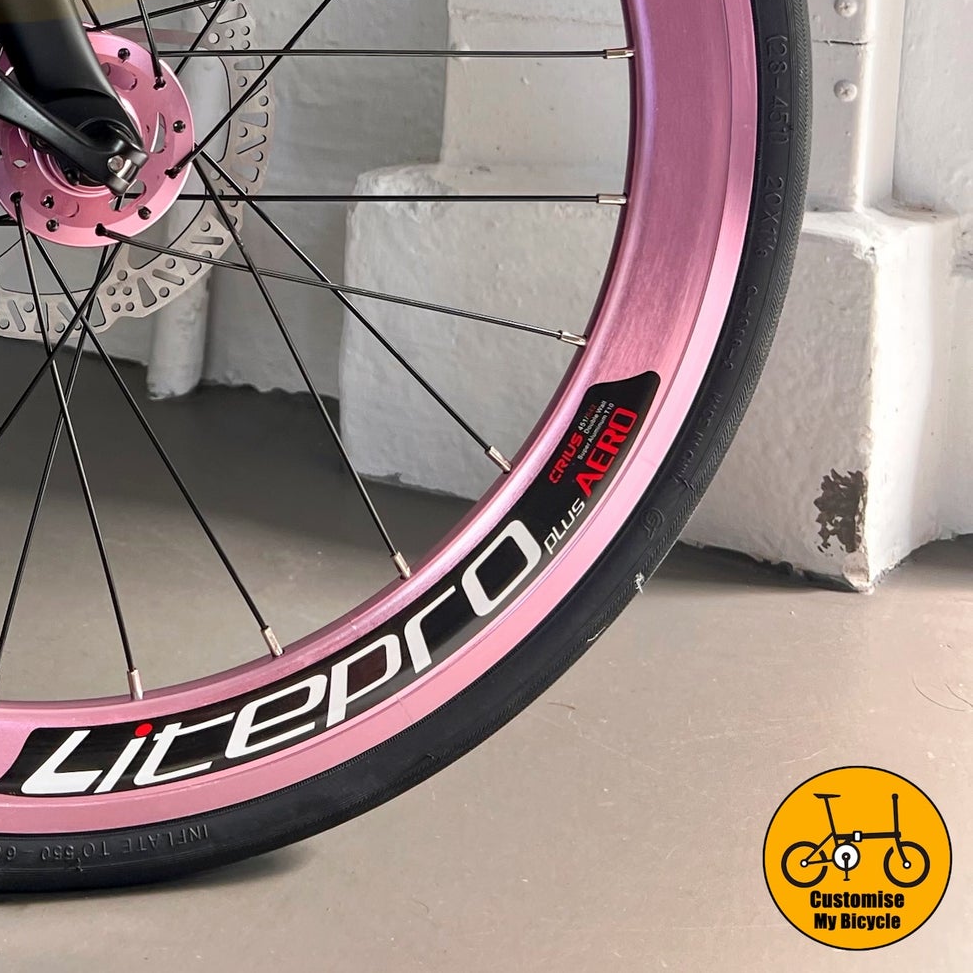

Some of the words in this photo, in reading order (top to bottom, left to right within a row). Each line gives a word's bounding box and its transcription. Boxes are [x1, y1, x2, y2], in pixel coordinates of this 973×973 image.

[548, 431, 584, 484] CRIUS
[575, 406, 639, 499] AERO
[20, 518, 543, 796] Litepro
[81, 839, 111, 859] TO
[119, 821, 212, 855] INFLATE
